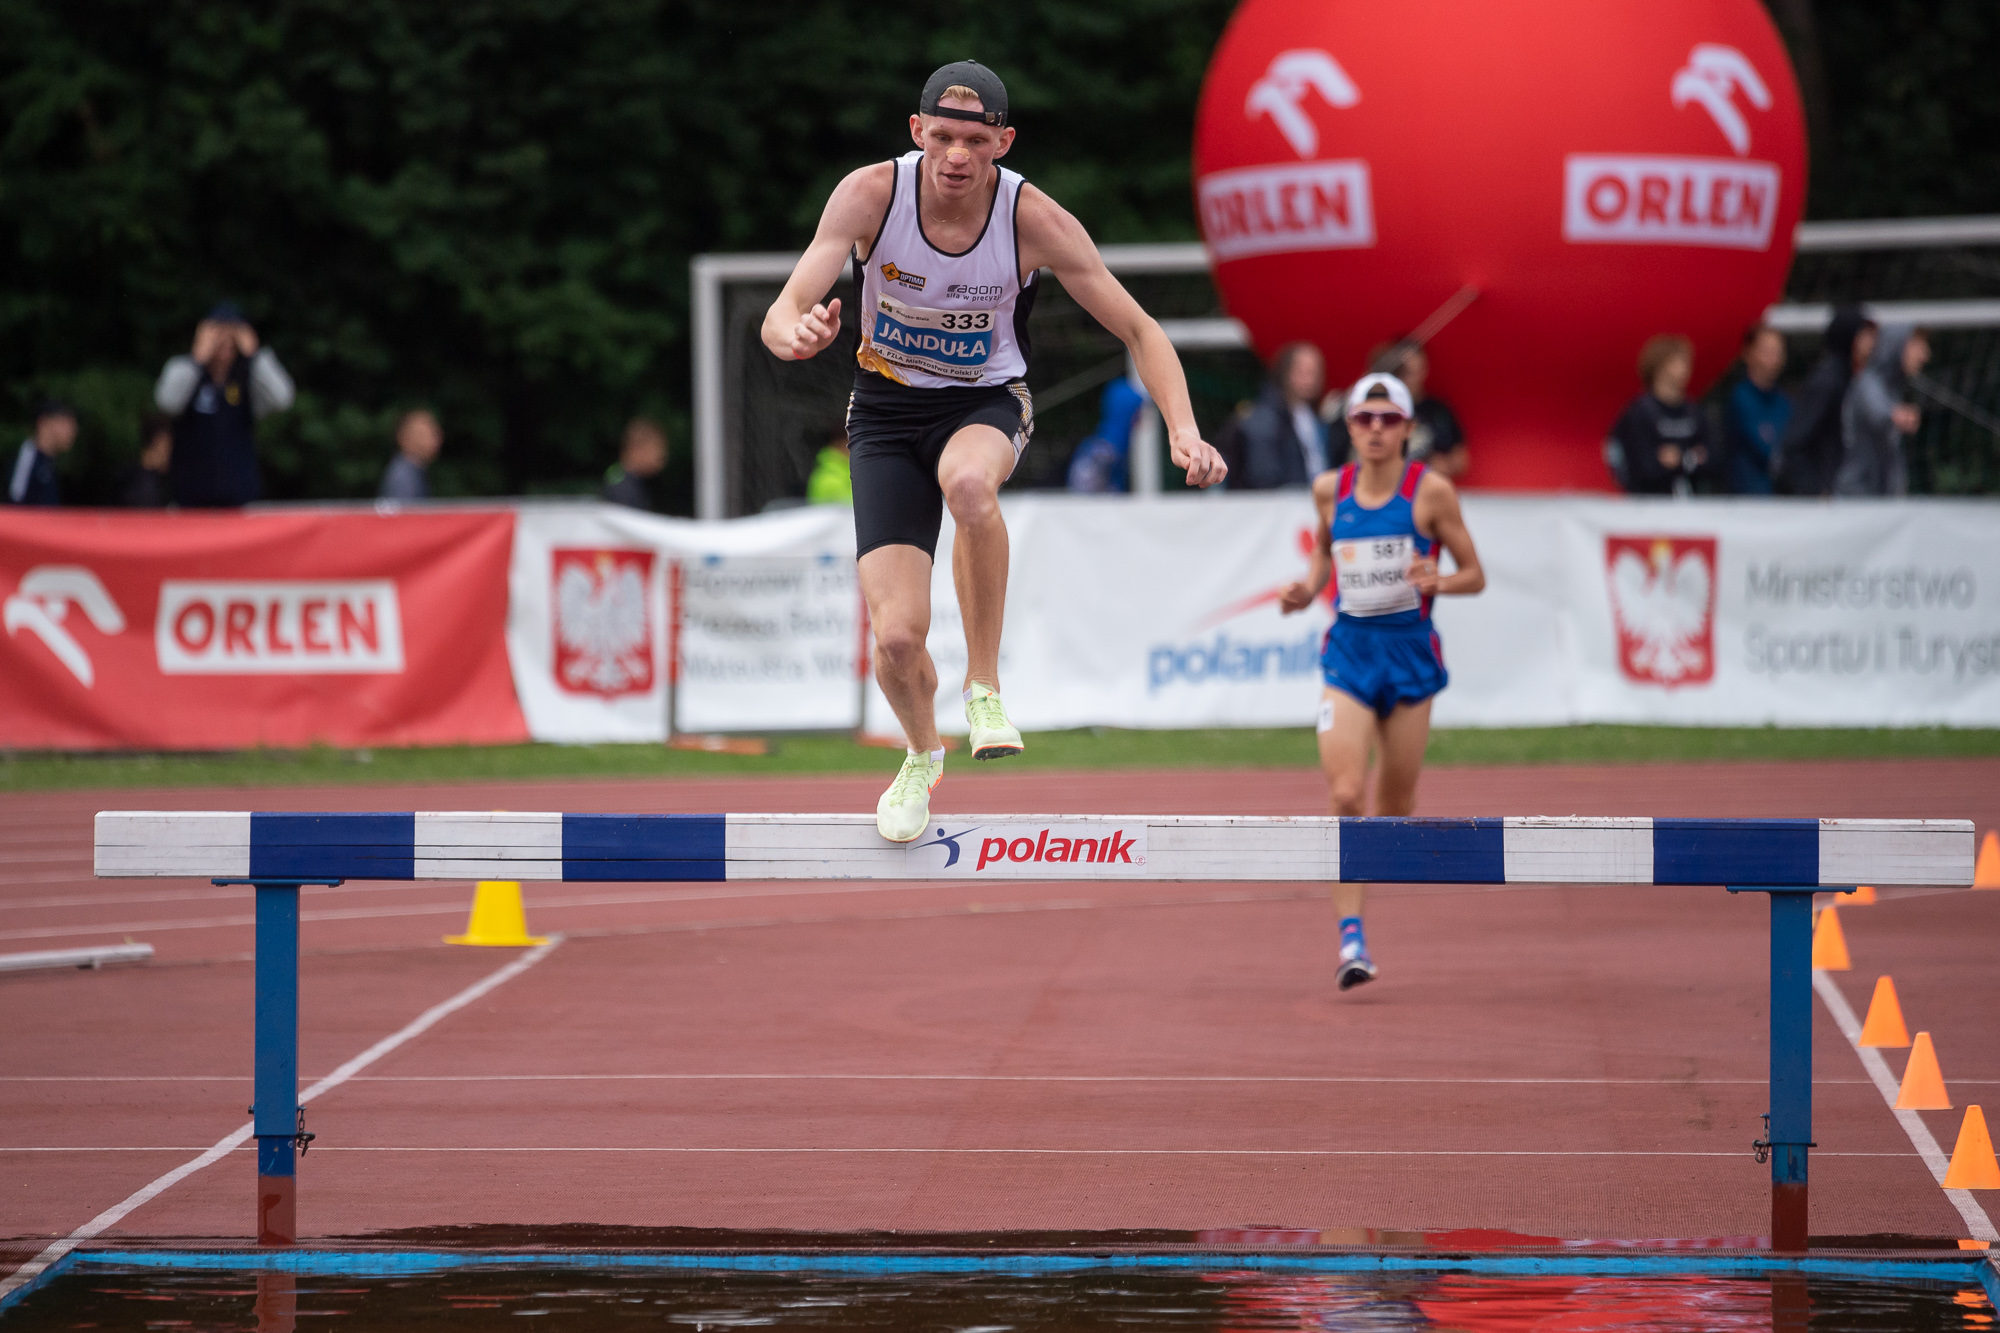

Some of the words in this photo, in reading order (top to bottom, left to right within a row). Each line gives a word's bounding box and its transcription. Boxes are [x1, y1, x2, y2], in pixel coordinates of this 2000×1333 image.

[1585, 174, 1767, 231] ORLEN
[900, 273, 924, 286] OPTIMA
[879, 322, 987, 358] JANDUŁA
[941, 313, 990, 330] 333
[905, 358, 948, 374] Mistrzostwa
[950, 369, 972, 377] Polski
[1745, 560, 1977, 609] Ministerstwo
[171, 596, 382, 658] ORLEN
[1744, 621, 1869, 680] Sportu
[976, 829, 1138, 872] polanik
